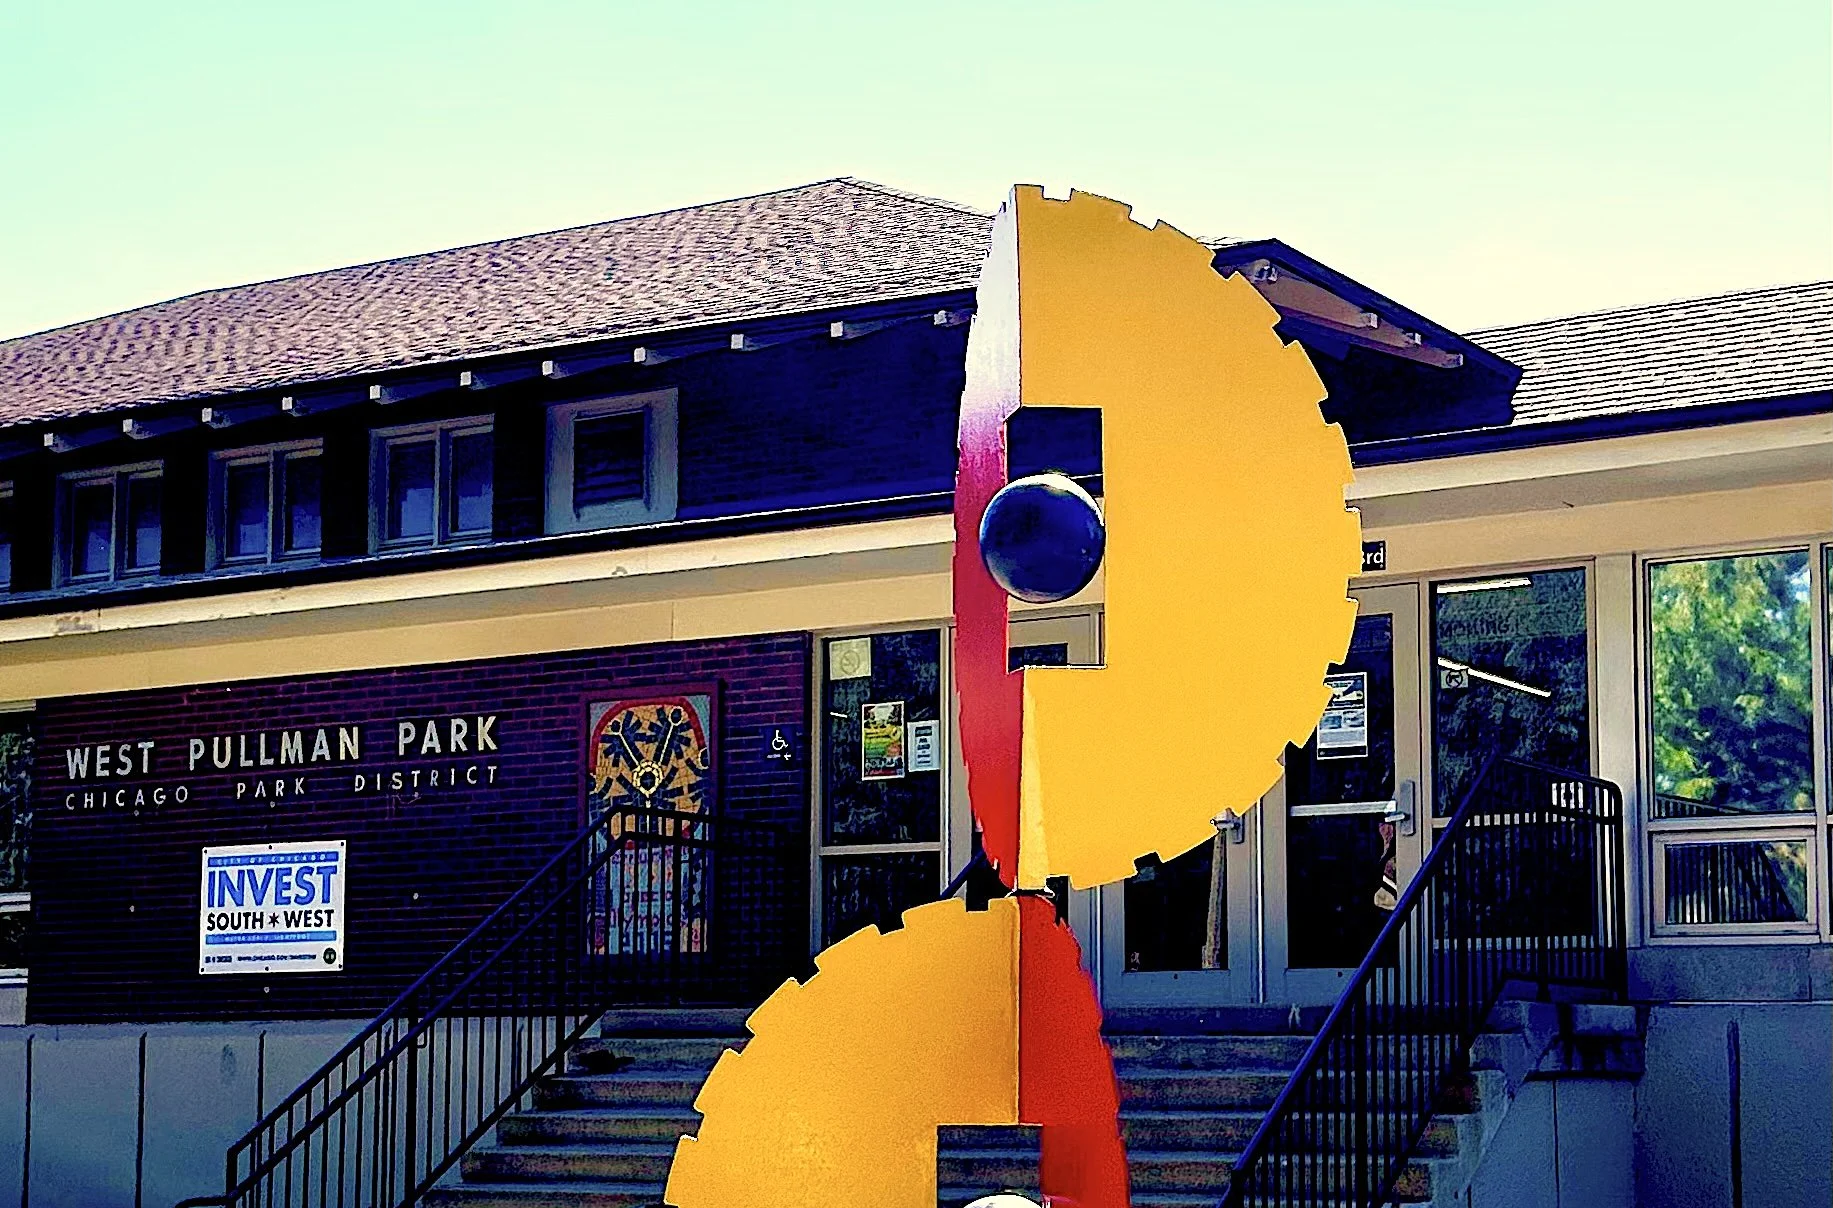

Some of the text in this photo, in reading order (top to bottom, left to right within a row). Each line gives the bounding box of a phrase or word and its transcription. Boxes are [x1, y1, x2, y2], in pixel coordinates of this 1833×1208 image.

[66, 716, 498, 780] WEST PULLMAN PARK
[65, 765, 498, 811] CHICAGO PARK DISTRICT
[207, 866, 338, 908] INVEST
[207, 909, 334, 931] SOUTH WEST
